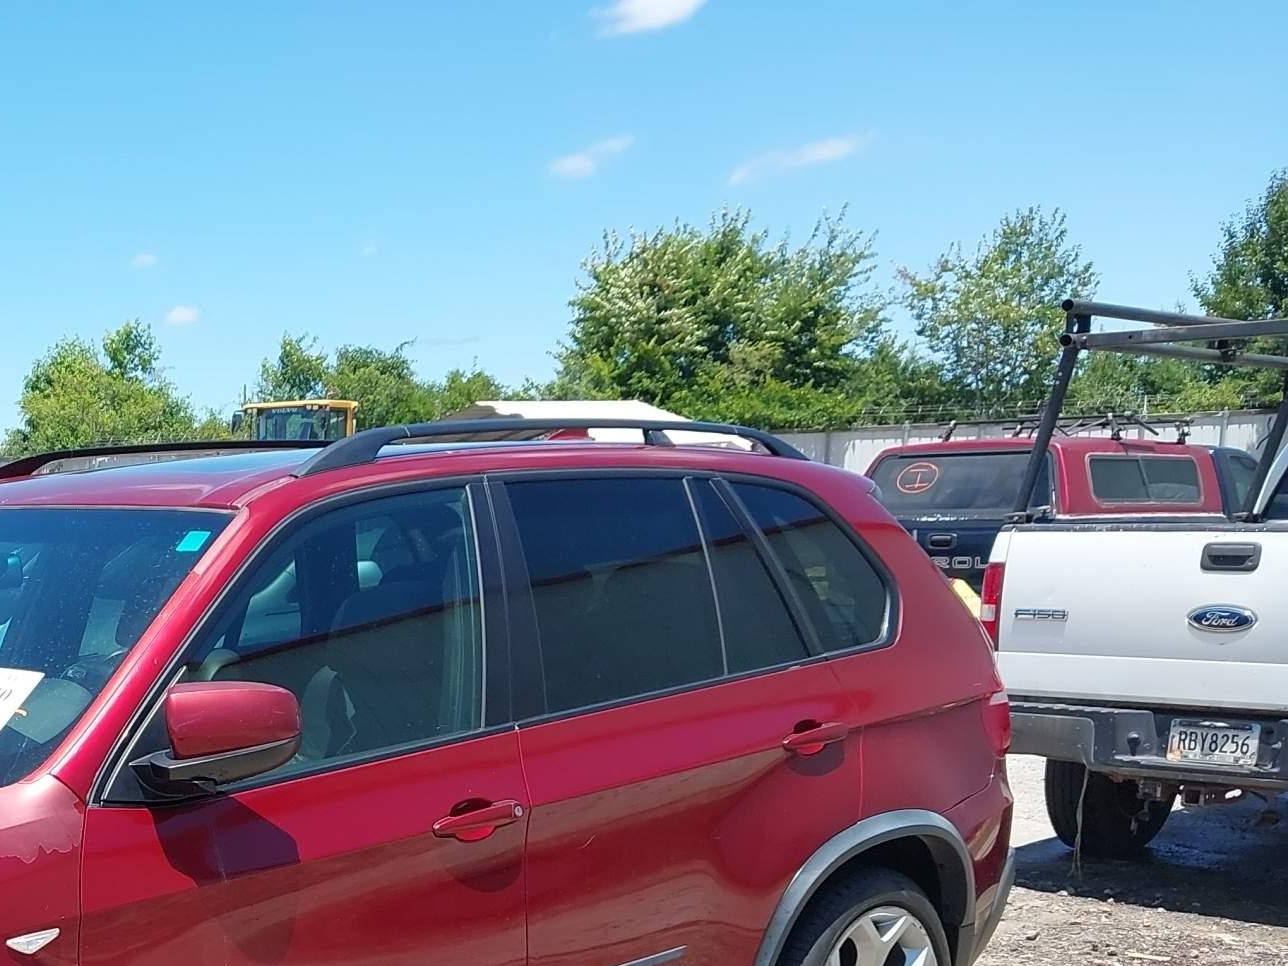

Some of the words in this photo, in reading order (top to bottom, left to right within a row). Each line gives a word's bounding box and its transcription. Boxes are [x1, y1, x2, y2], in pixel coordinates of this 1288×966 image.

[1014, 608, 1068, 622] F150
[1201, 611, 1242, 626] Ford
[1177, 730, 1251, 755] RBY8256
